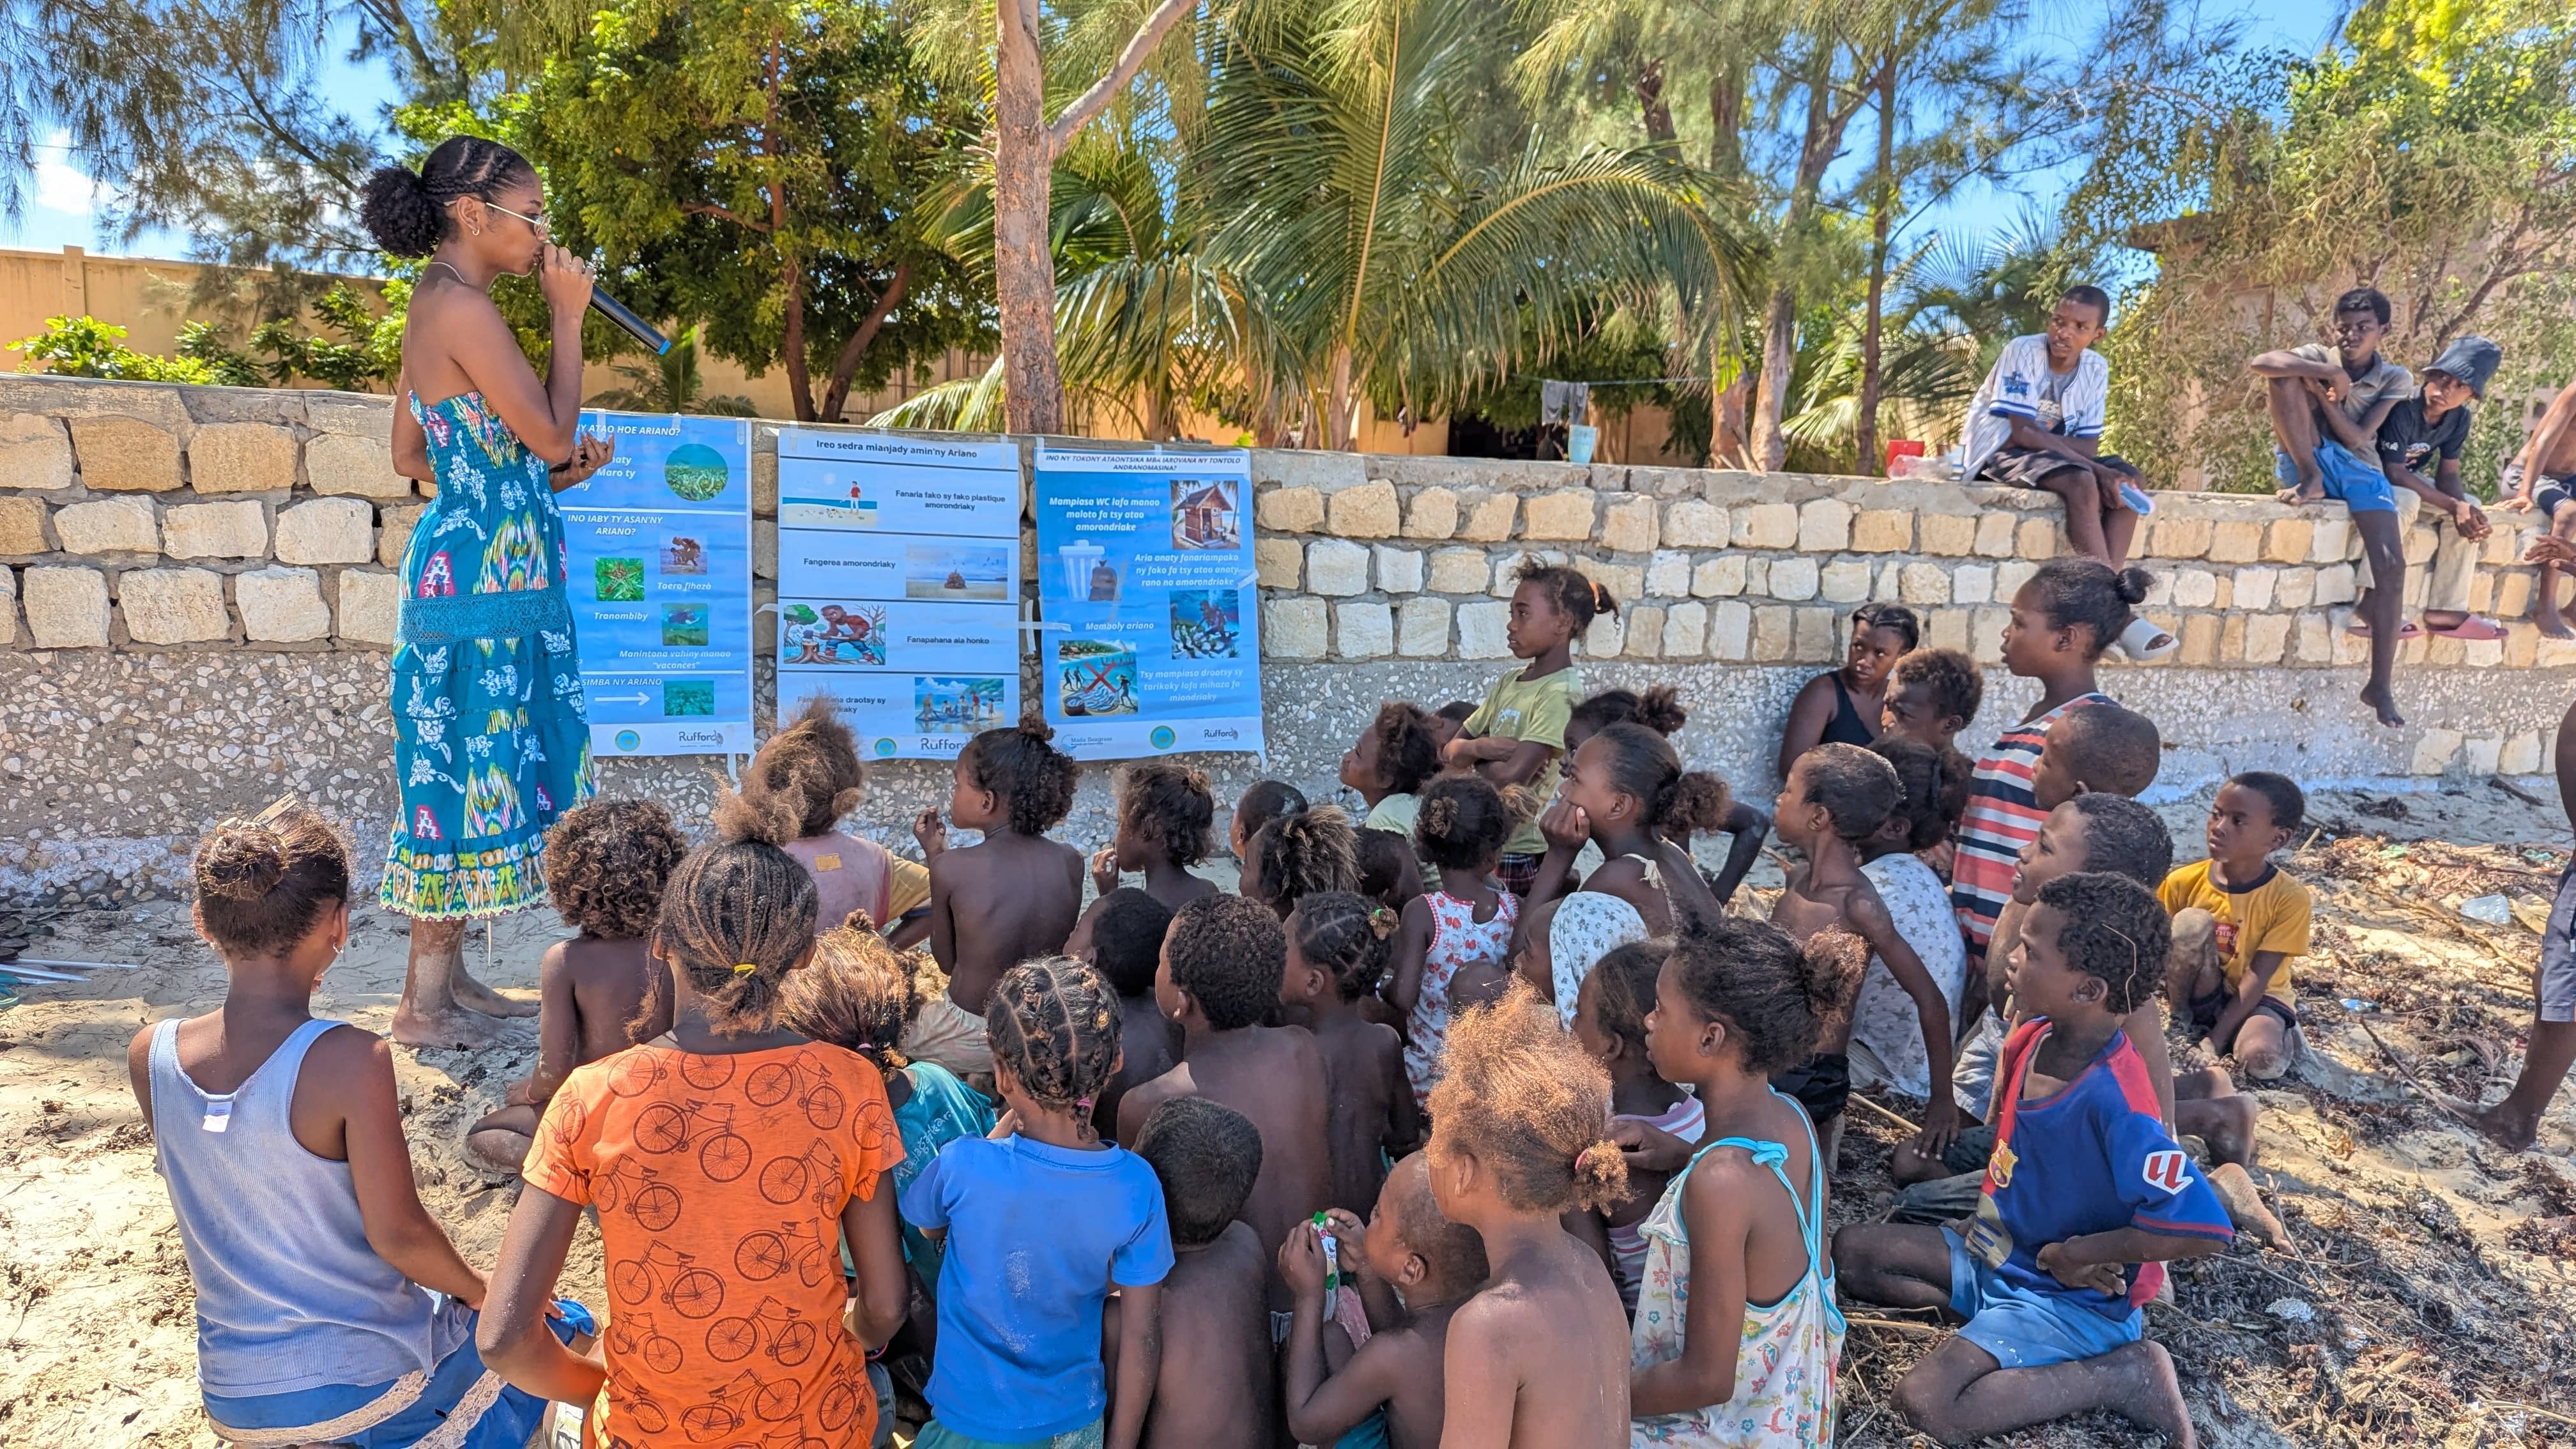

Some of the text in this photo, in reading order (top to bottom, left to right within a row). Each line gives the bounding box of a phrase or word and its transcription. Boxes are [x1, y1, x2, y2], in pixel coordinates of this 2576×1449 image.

[588, 425, 615, 433] ATAO
[617, 426, 638, 434] HOE
[639, 427, 681, 436] ARIANO?
[816, 440, 977, 458] Ireo sedra mianjady amin'ny Ariano
[597, 468, 636, 479] Maro ty
[895, 490, 923, 498] Fanaria
[971, 494, 1006, 503] plastique
[924, 502, 976, 512] amorondriaky
[1049, 497, 1094, 508] Mampiasa
[1096, 497, 1110, 506] WC
[1112, 497, 1129, 508] lafa
[623, 516, 663, 524] ASAN'NY
[1066, 510, 1145, 521] maloto fa tsy atao
[595, 528, 636, 536] ARIANO?
[1075, 522, 1137, 532] amorondriake
[1135, 553, 1153, 562] Aria
[1154, 554, 1179, 564] anaty
[843, 559, 896, 569] amorondriaky
[1136, 567, 1146, 576] ny
[1147, 566, 1167, 576] fako
[1167, 566, 1177, 576] fa
[1179, 567, 1192, 576] tsy
[594, 612, 648, 622] Tranombiby
[1086, 622, 1154, 632] Mamboly ariano
[907, 636, 952, 645] Fanapahana
[619, 650, 668, 658] Manintona
[670, 650, 699, 659] vahiny
[1140, 671, 1154, 680] Tsy
[1234, 669, 1243, 677] sy
[1230, 680, 1240, 689] fa
[845, 696, 875, 705] draotsy
[678, 730, 717, 742] Rufford
[1204, 727, 1233, 738] Rufford
[921, 737, 965, 750] Ruffor
